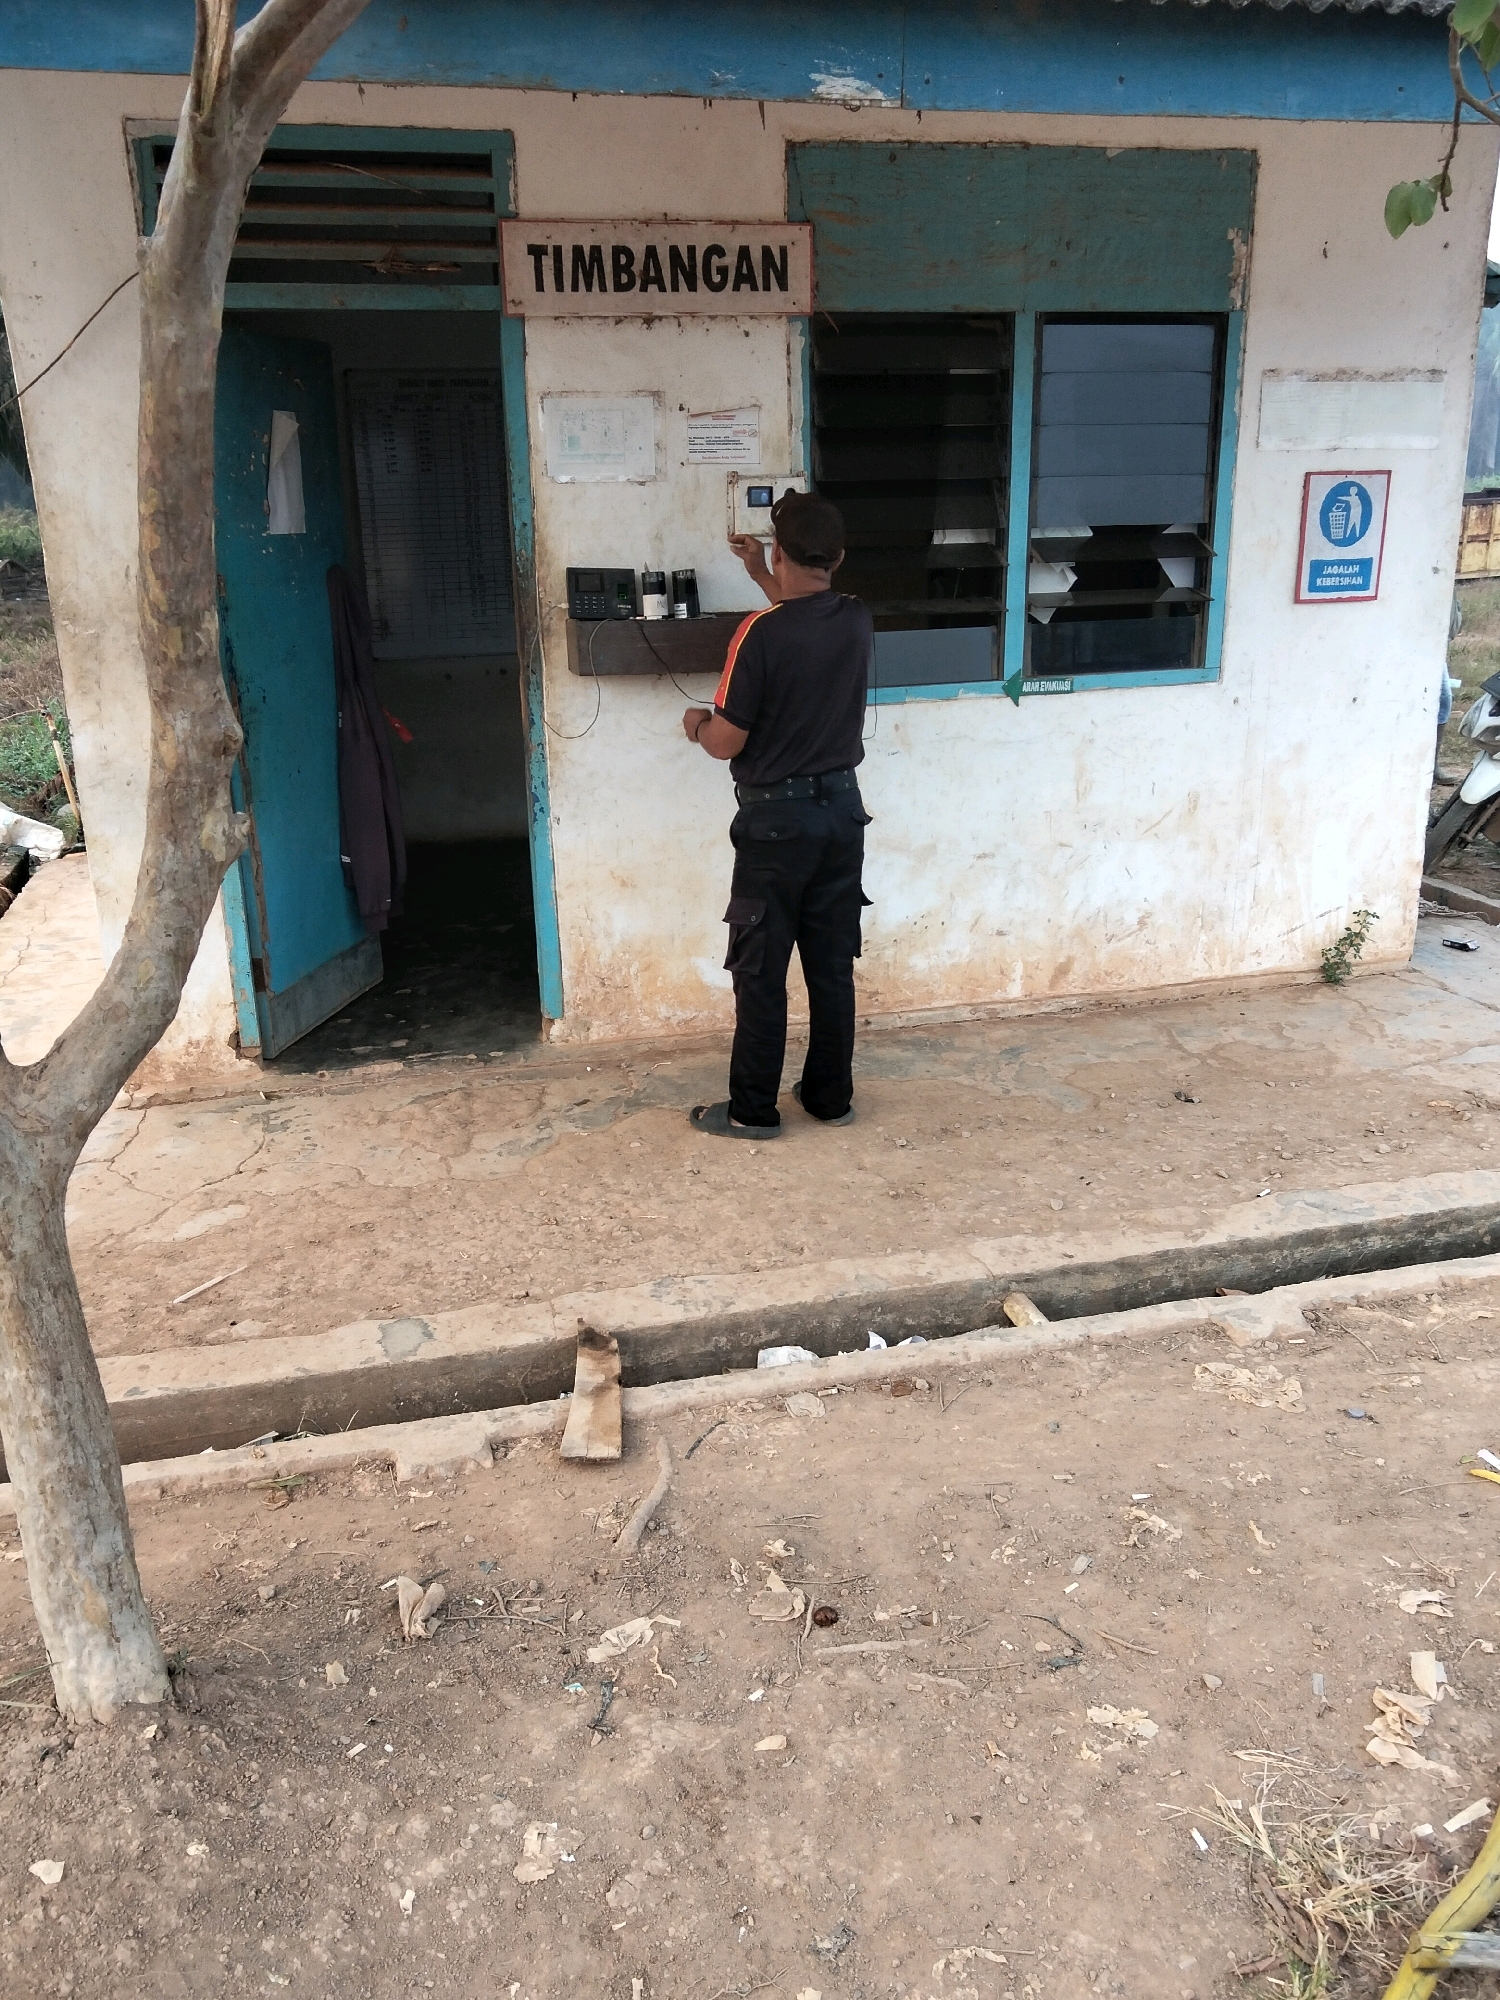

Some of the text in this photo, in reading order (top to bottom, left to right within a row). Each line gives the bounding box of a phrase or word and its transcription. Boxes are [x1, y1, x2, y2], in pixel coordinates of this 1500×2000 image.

[527, 243, 789, 293] TIMBANGAN
[1323, 565, 1359, 574] JAGALAH
[1316, 576, 1363, 586] KEBERSIHAN
[1022, 681, 1070, 692] ARAH EVAKUASI
